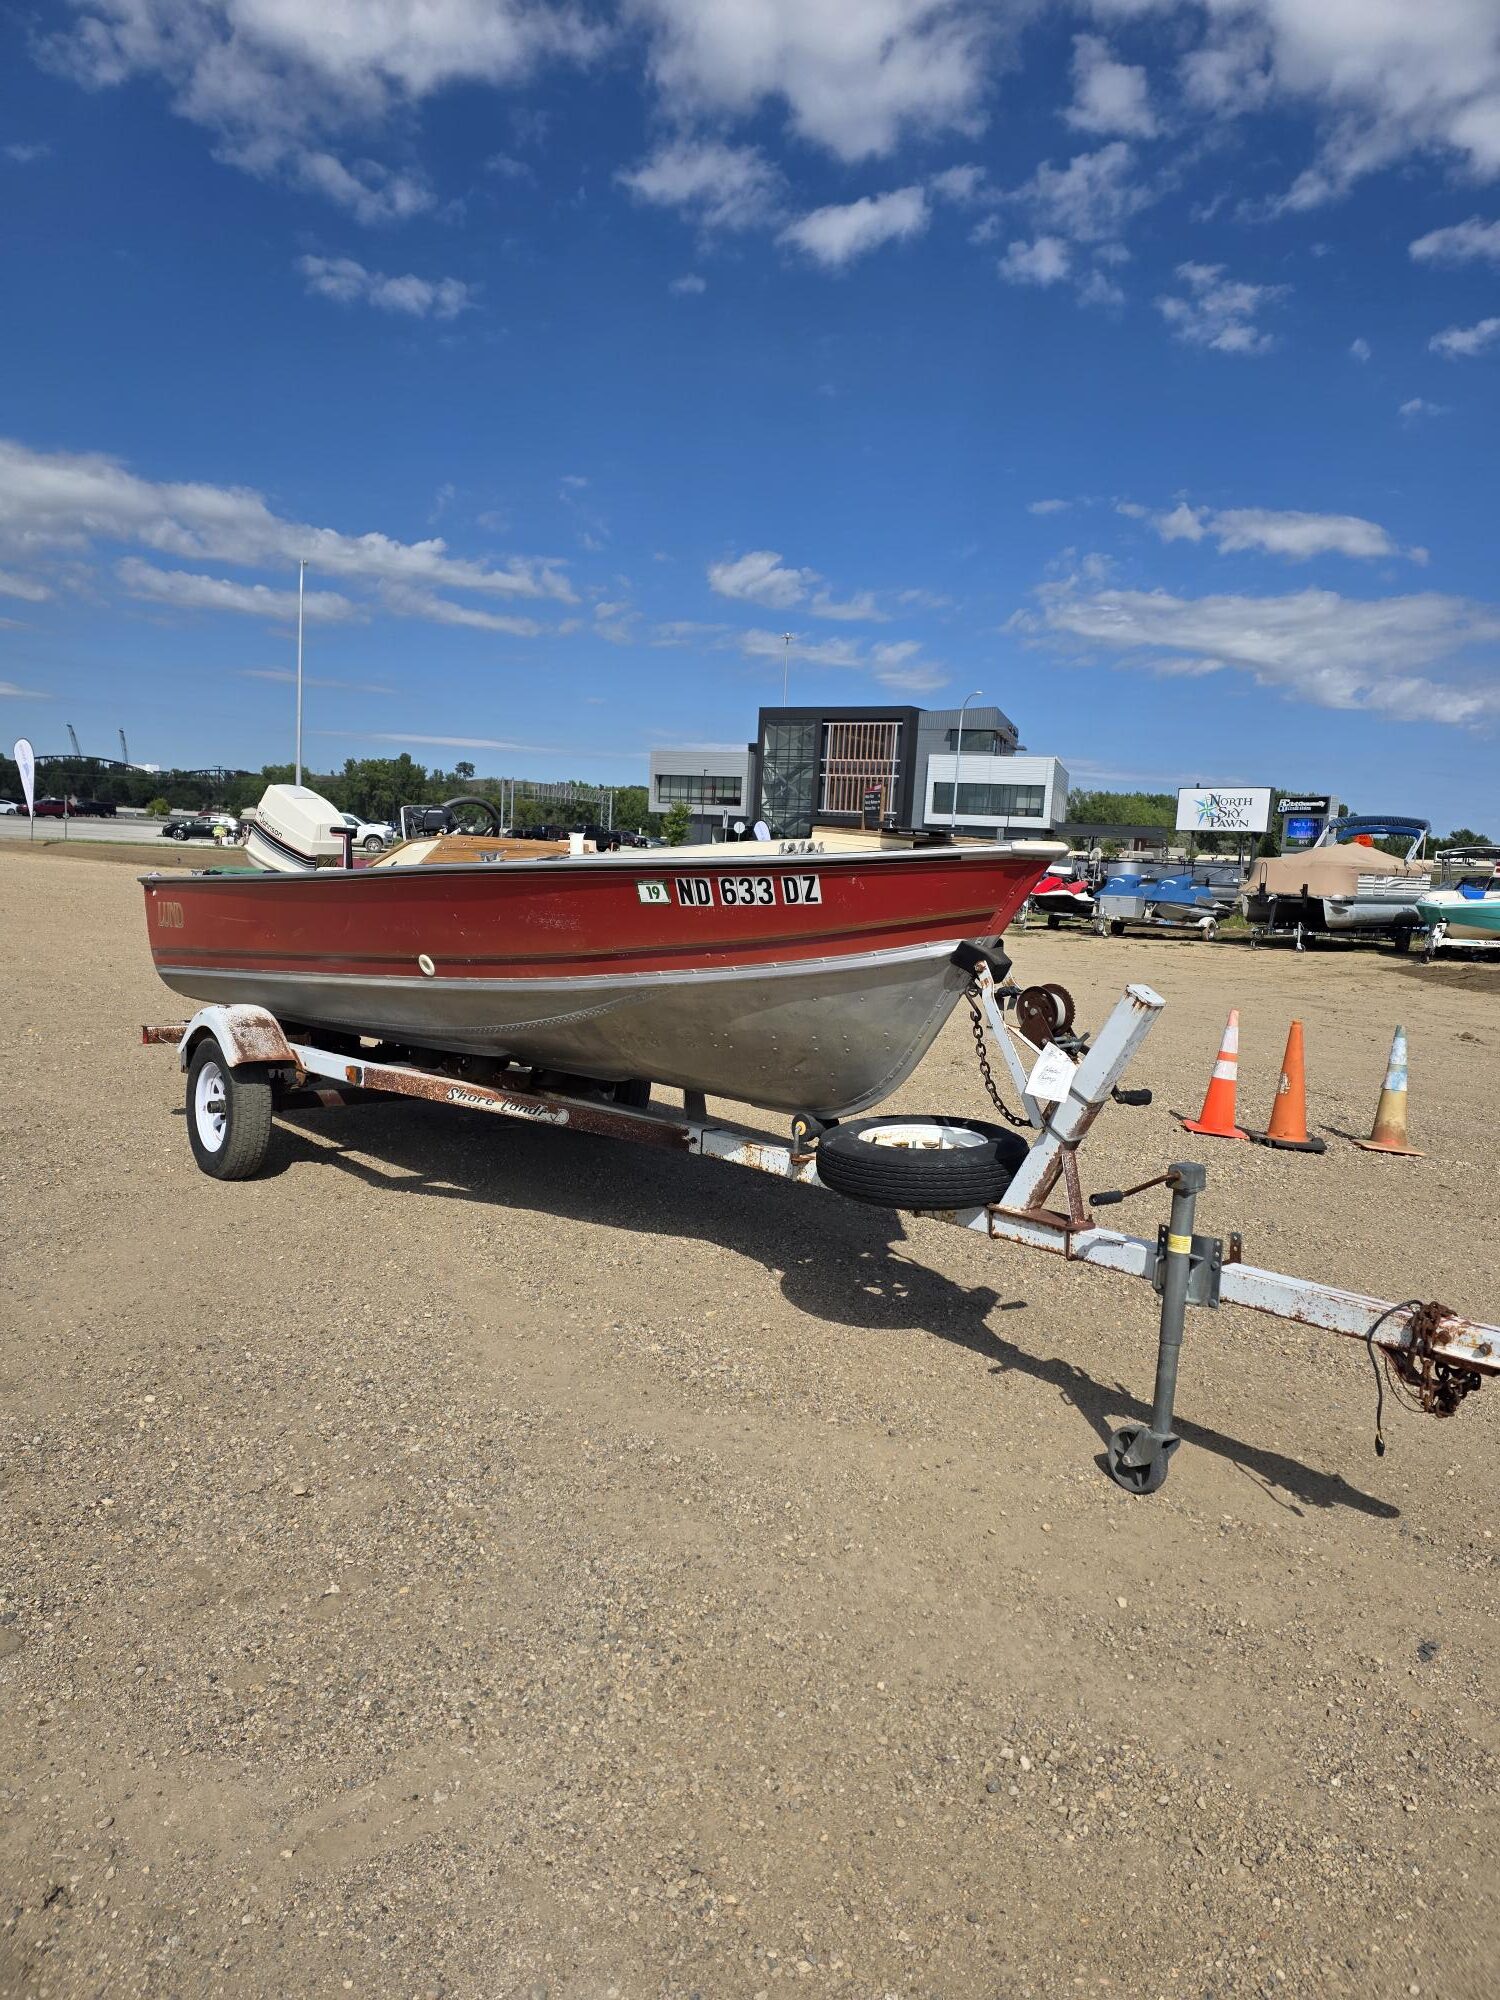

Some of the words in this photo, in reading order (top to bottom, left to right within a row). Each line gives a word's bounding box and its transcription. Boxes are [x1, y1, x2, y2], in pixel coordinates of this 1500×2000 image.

[646, 886, 660, 899] 19
[677, 878, 711, 905] ND
[720, 877, 774, 905] 633
[783, 876, 818, 904] DZ
[446, 1087, 494, 1106] Shore
